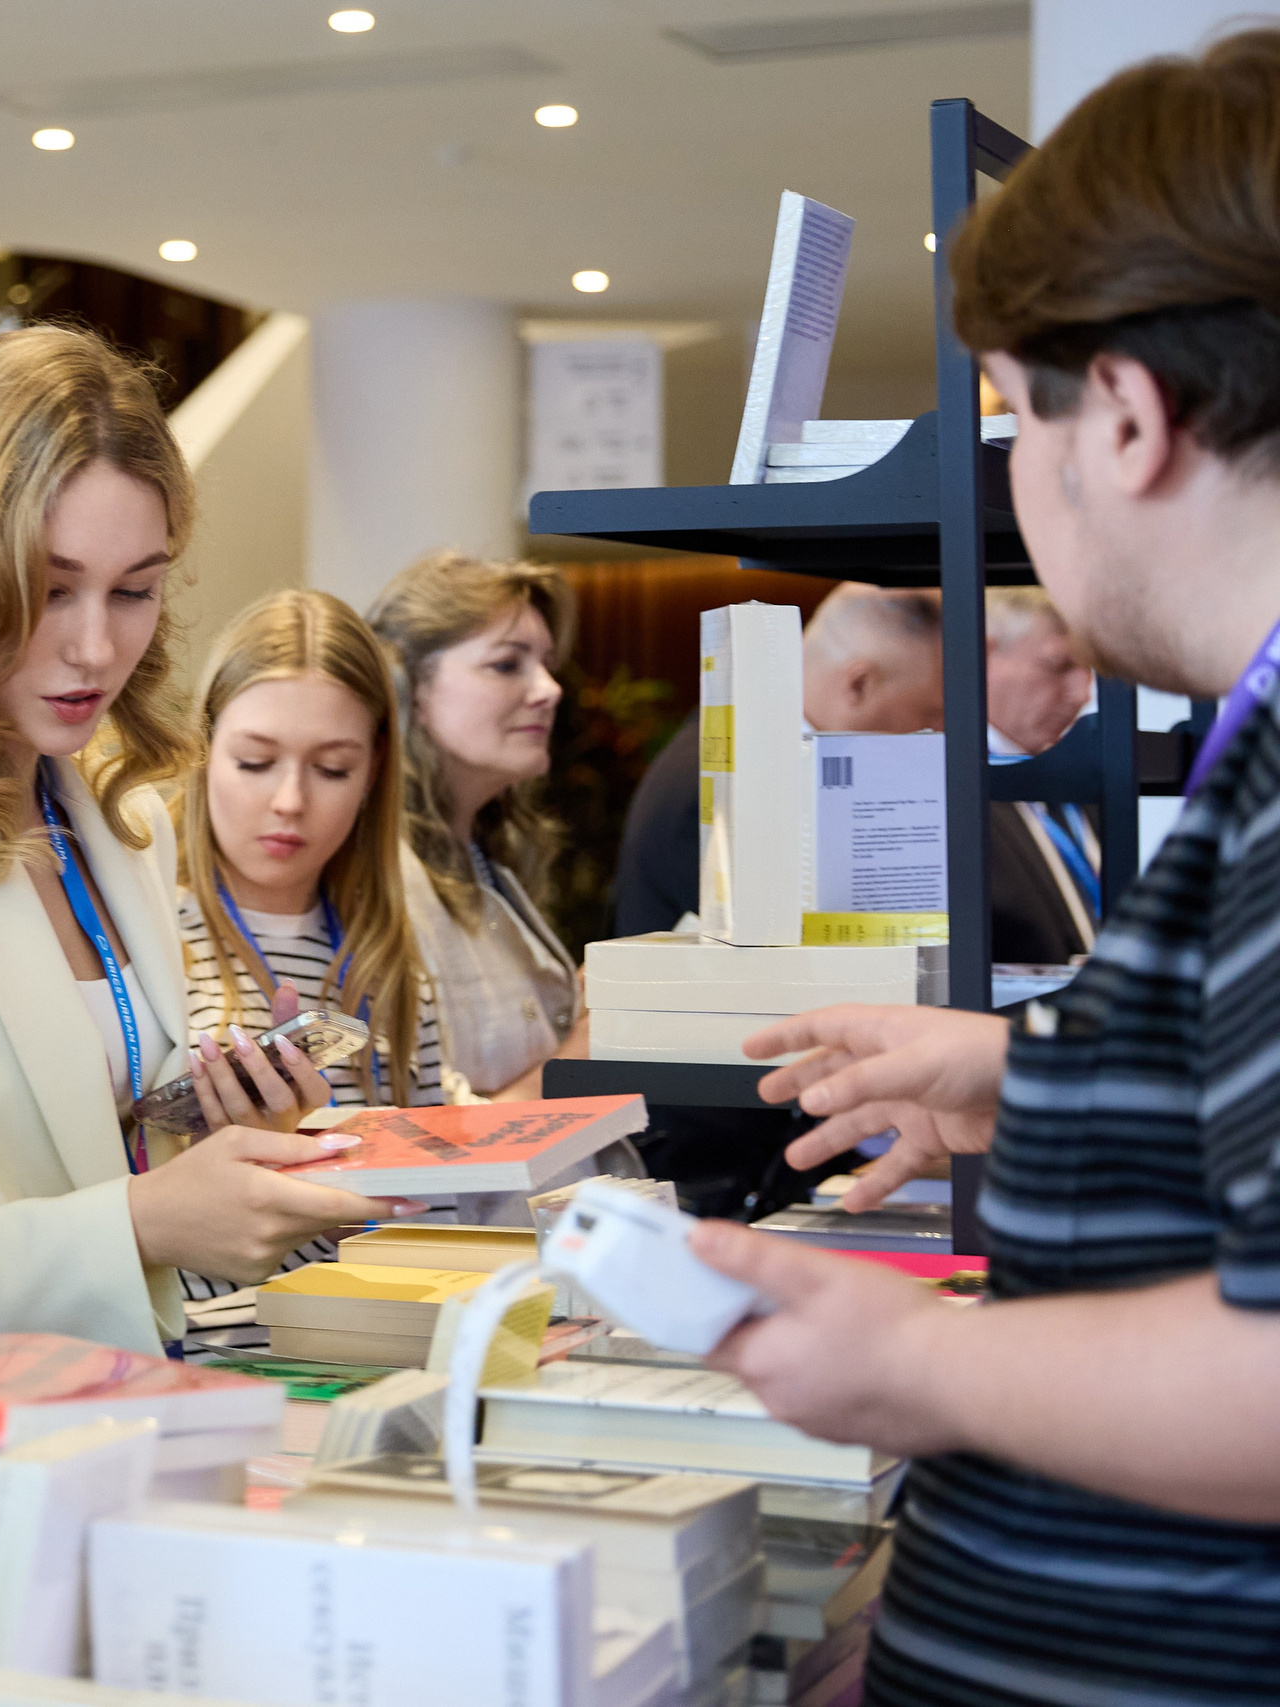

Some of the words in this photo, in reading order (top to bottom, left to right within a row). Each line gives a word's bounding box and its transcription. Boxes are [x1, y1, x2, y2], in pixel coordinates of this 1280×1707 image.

[104, 955, 124, 995] BRICS
[117, 997, 137, 1044] URBAN
[129, 1045, 143, 1100] FUTURE
